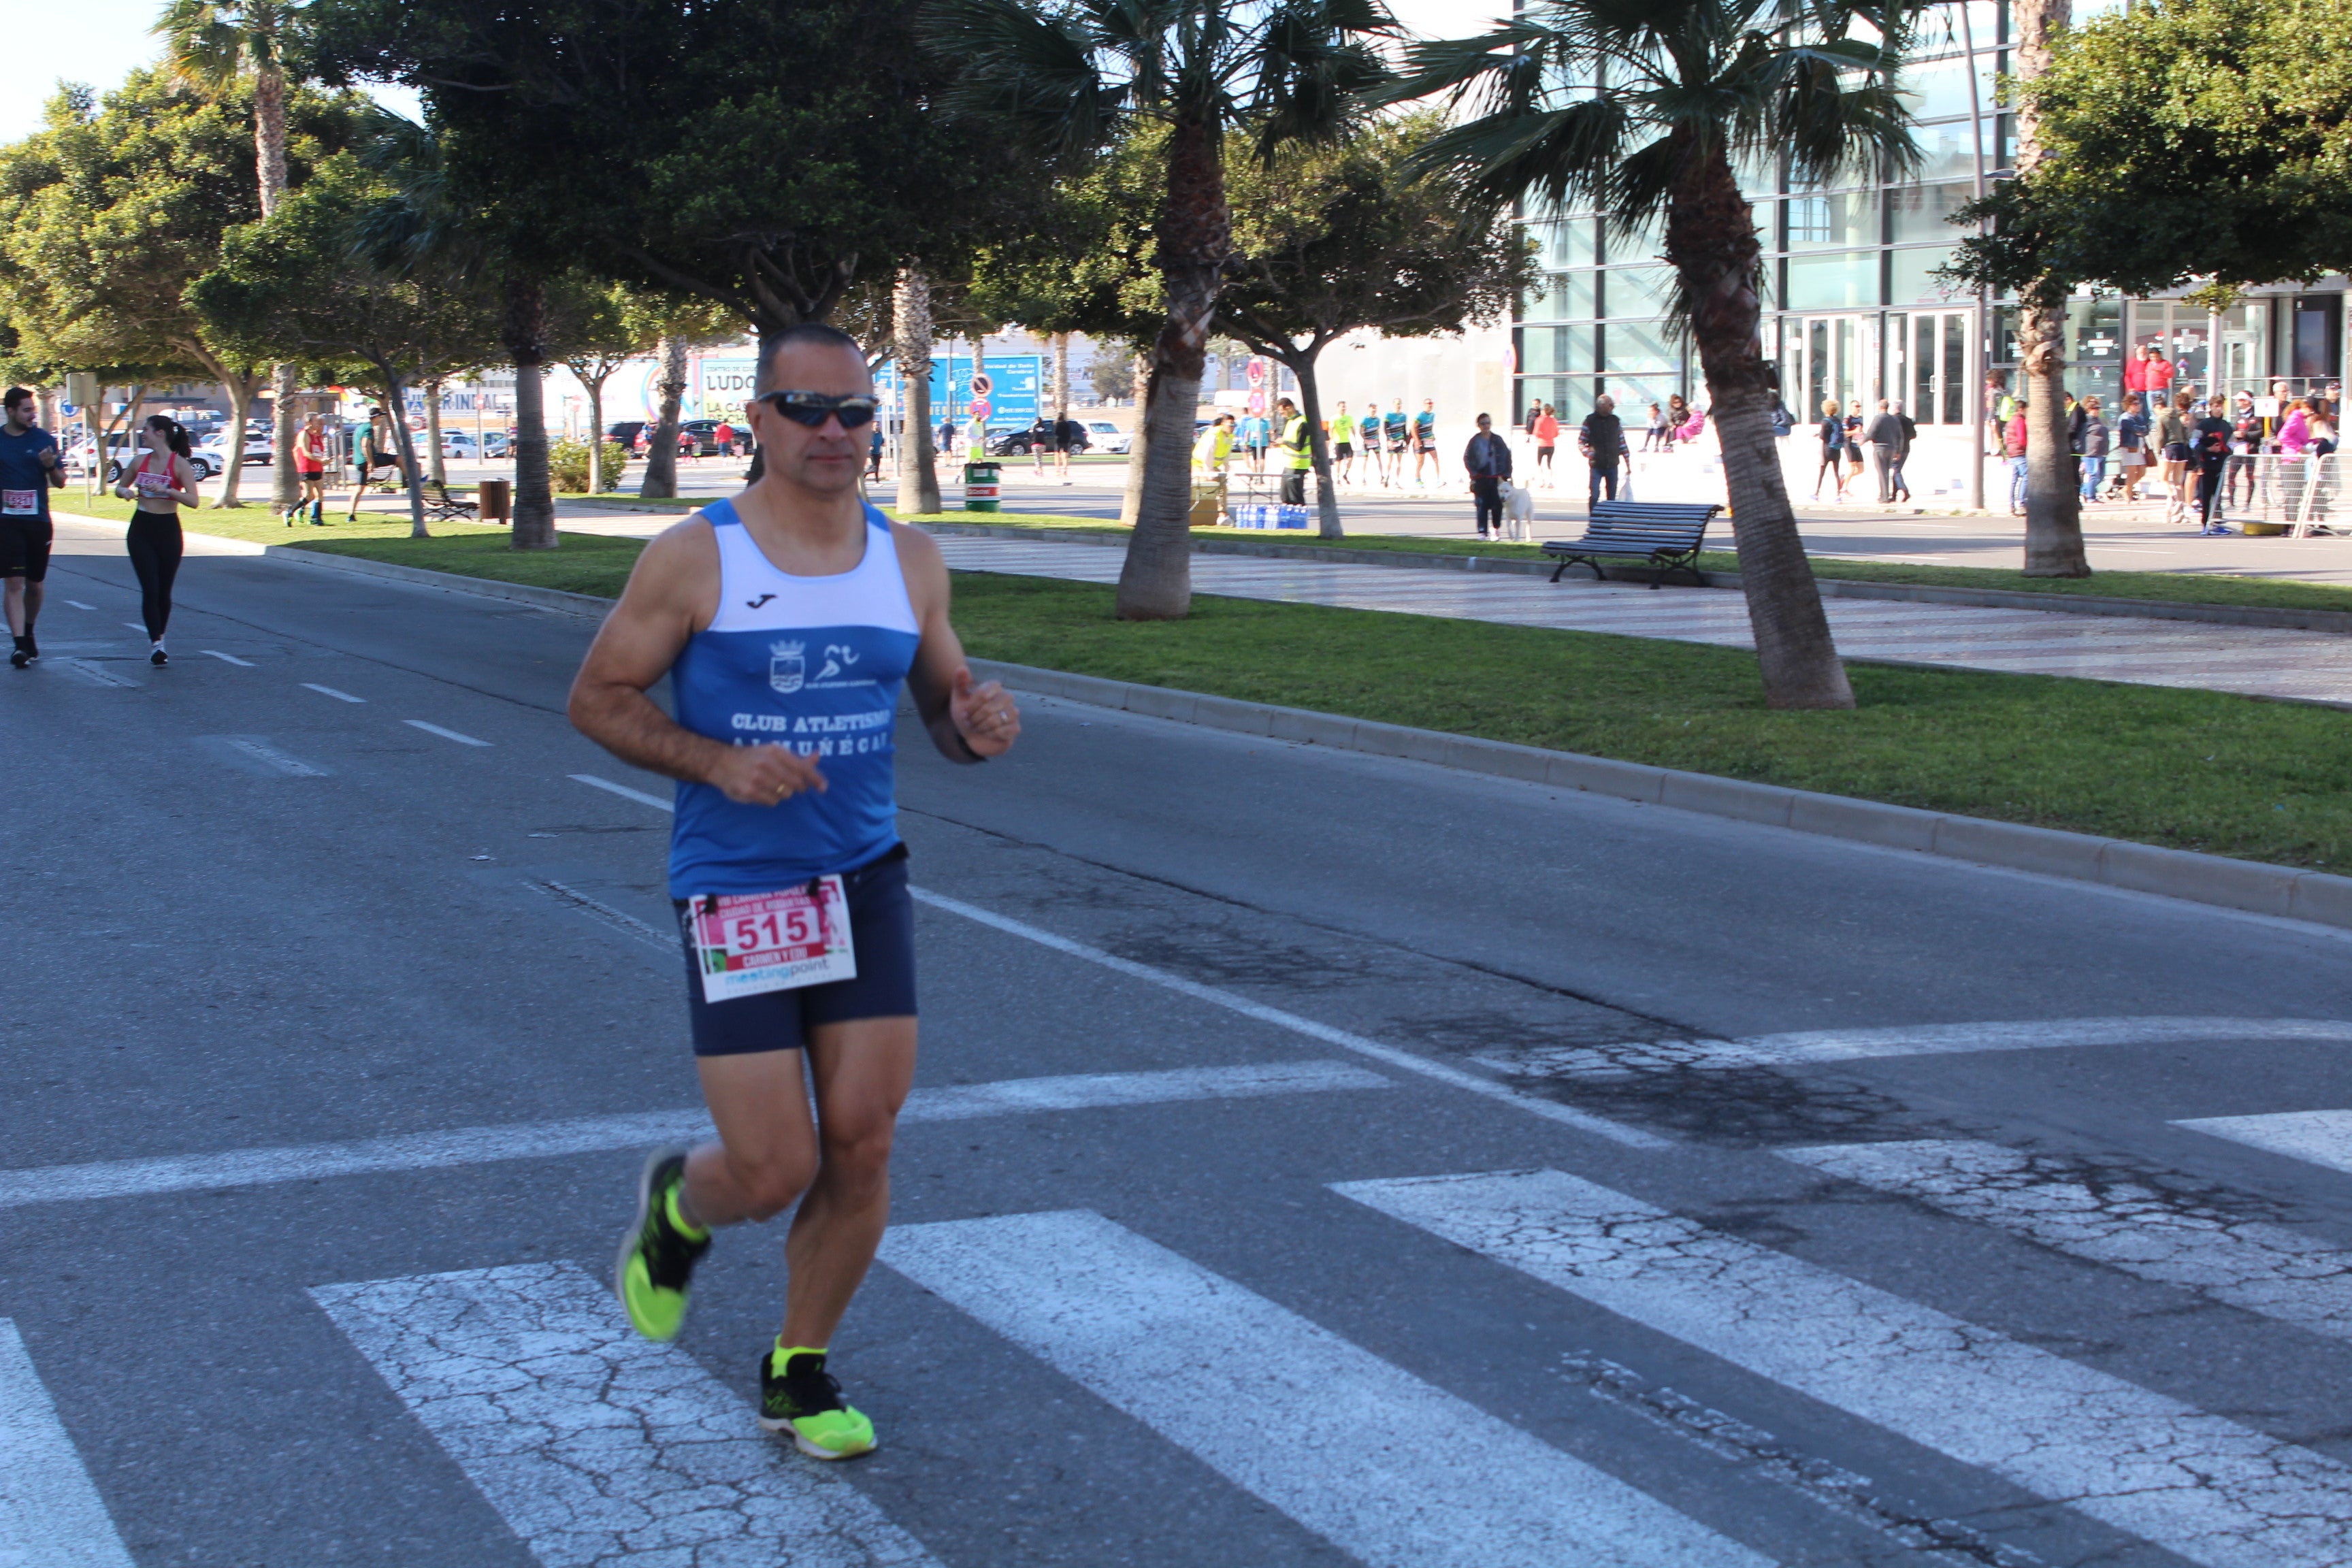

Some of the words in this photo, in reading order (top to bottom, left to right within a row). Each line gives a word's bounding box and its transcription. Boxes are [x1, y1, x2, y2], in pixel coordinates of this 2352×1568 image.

[706, 403, 721, 412] LA
[731, 713, 787, 732] CLUB
[793, 709, 891, 733] ATLETISMO
[732, 892, 773, 904] CARRERA
[719, 904, 752, 919] CIUDAD
[752, 902, 764, 915] DE
[737, 911, 808, 951] 515
[742, 951, 782, 968] CARMEN
[725, 958, 830, 985] meetingpoint
